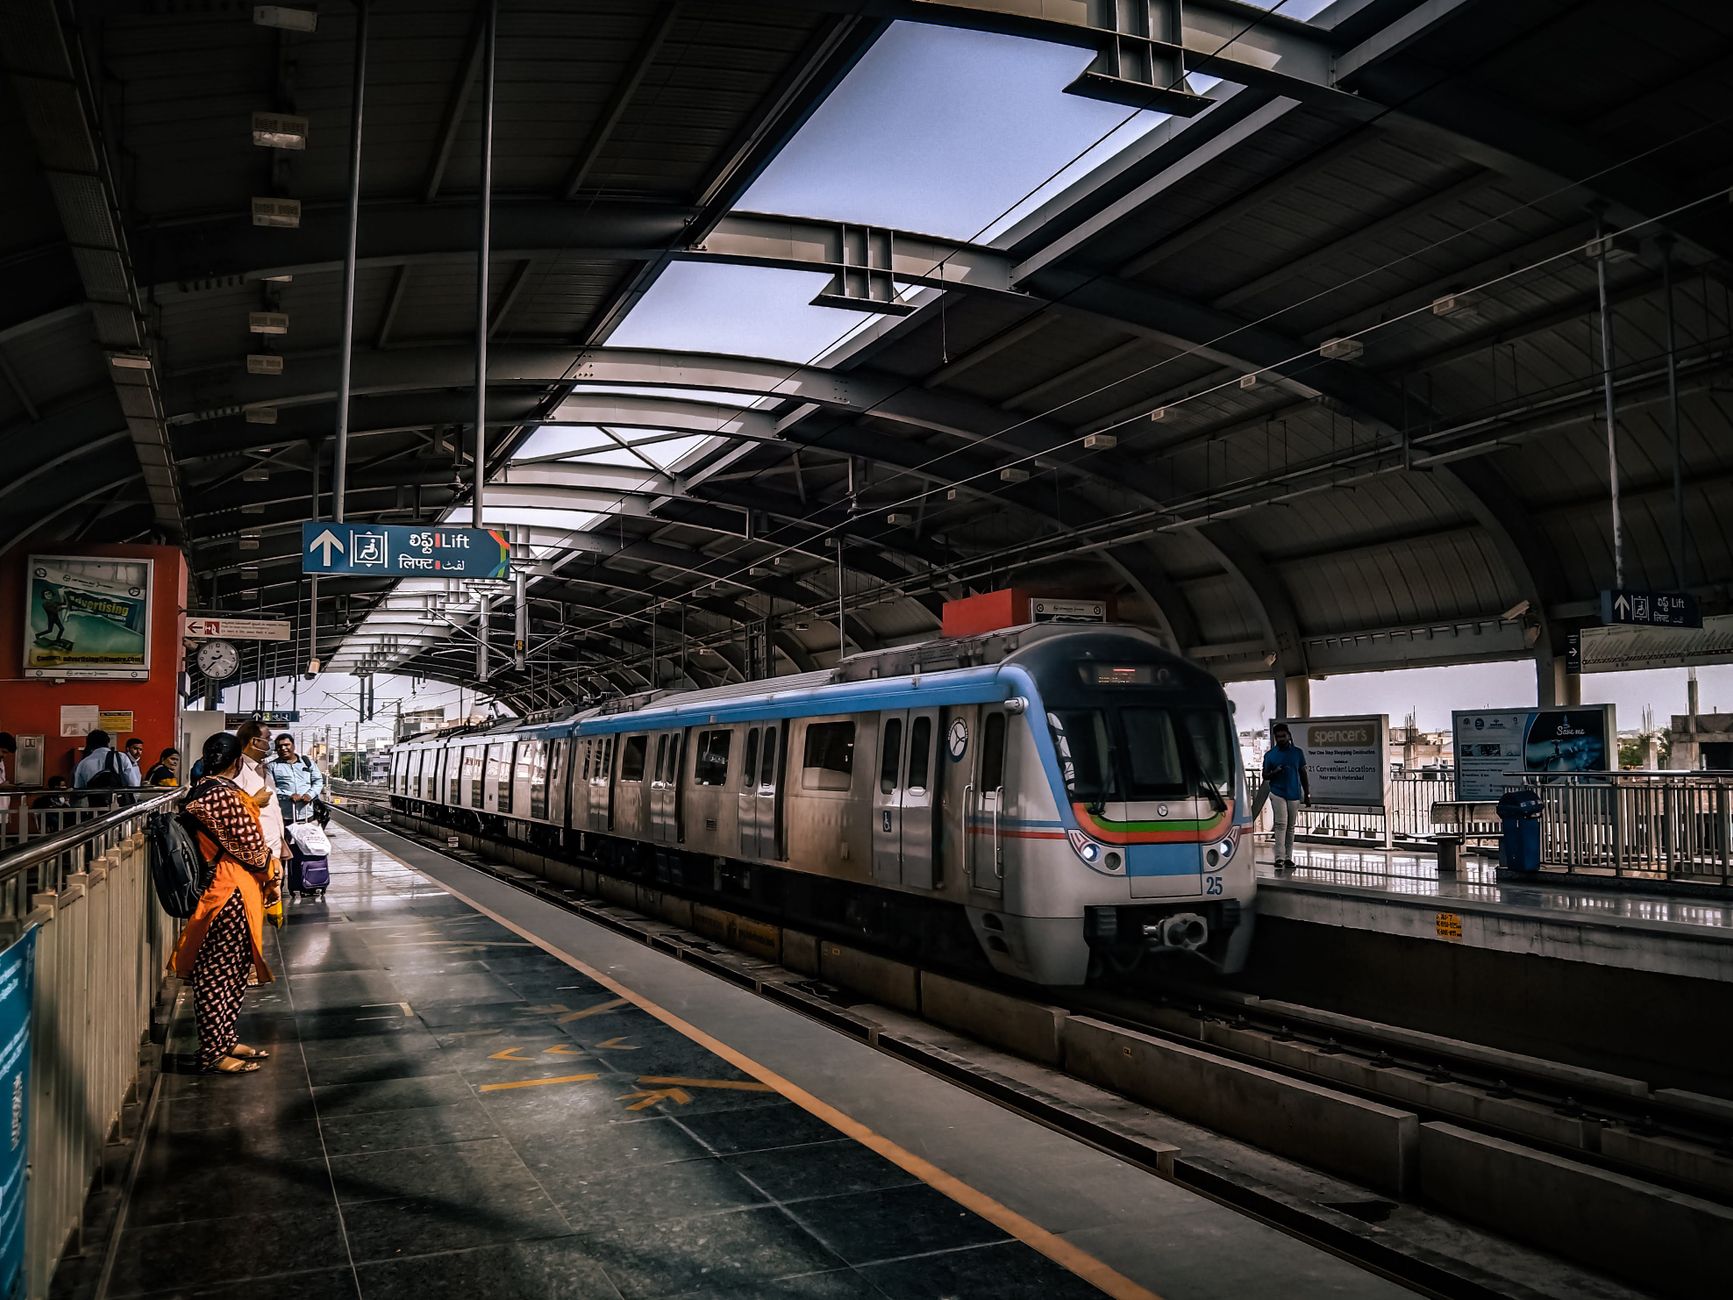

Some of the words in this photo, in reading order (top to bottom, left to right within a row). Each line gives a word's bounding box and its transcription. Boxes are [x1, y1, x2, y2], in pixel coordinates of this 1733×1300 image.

[442, 534, 470, 548] Lift
[398, 553, 434, 570] लिफ्ट
[1671, 597, 1685, 609] Lift
[1314, 729, 1367, 746] spencer's
[1556, 725, 1574, 736] Save
[1316, 765, 1347, 773] Convenient
[1348, 765, 1376, 773] Locations
[1206, 876, 1223, 895] 25
